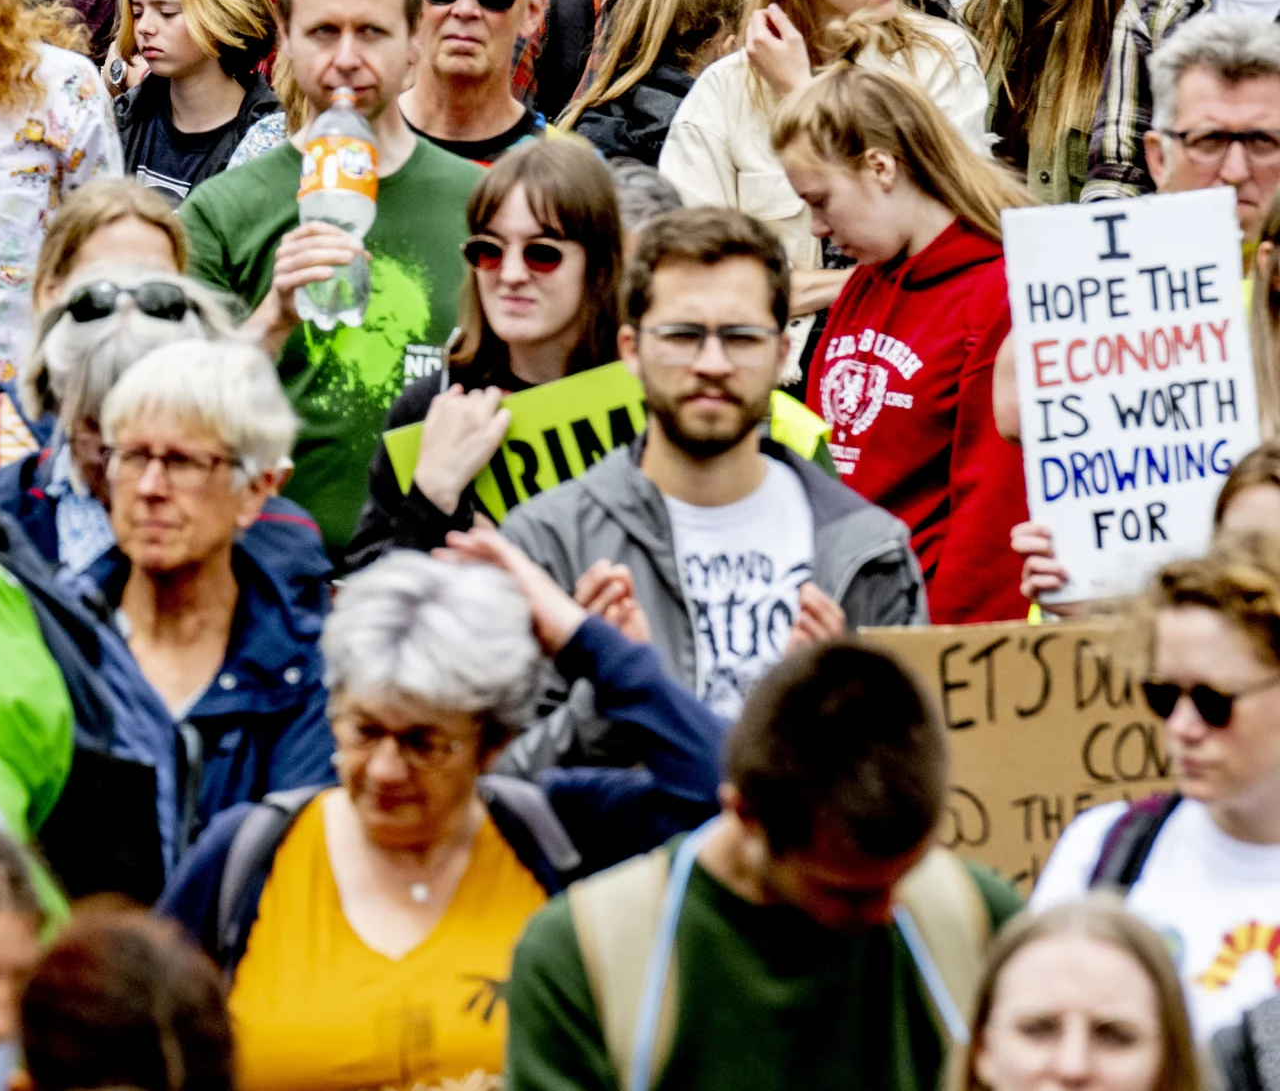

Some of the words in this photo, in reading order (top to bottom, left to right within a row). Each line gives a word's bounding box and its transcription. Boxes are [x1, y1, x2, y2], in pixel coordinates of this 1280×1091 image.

[1092, 213, 1131, 261] I
[1026, 277, 1130, 324] HOPE
[1138, 264, 1220, 311] THE
[1030, 319, 1232, 388] ECONOMY
[1037, 394, 1090, 443] IS
[1110, 379, 1240, 431] WORTH
[1039, 439, 1234, 503] DROWNING
[1092, 502, 1169, 550] FOR
